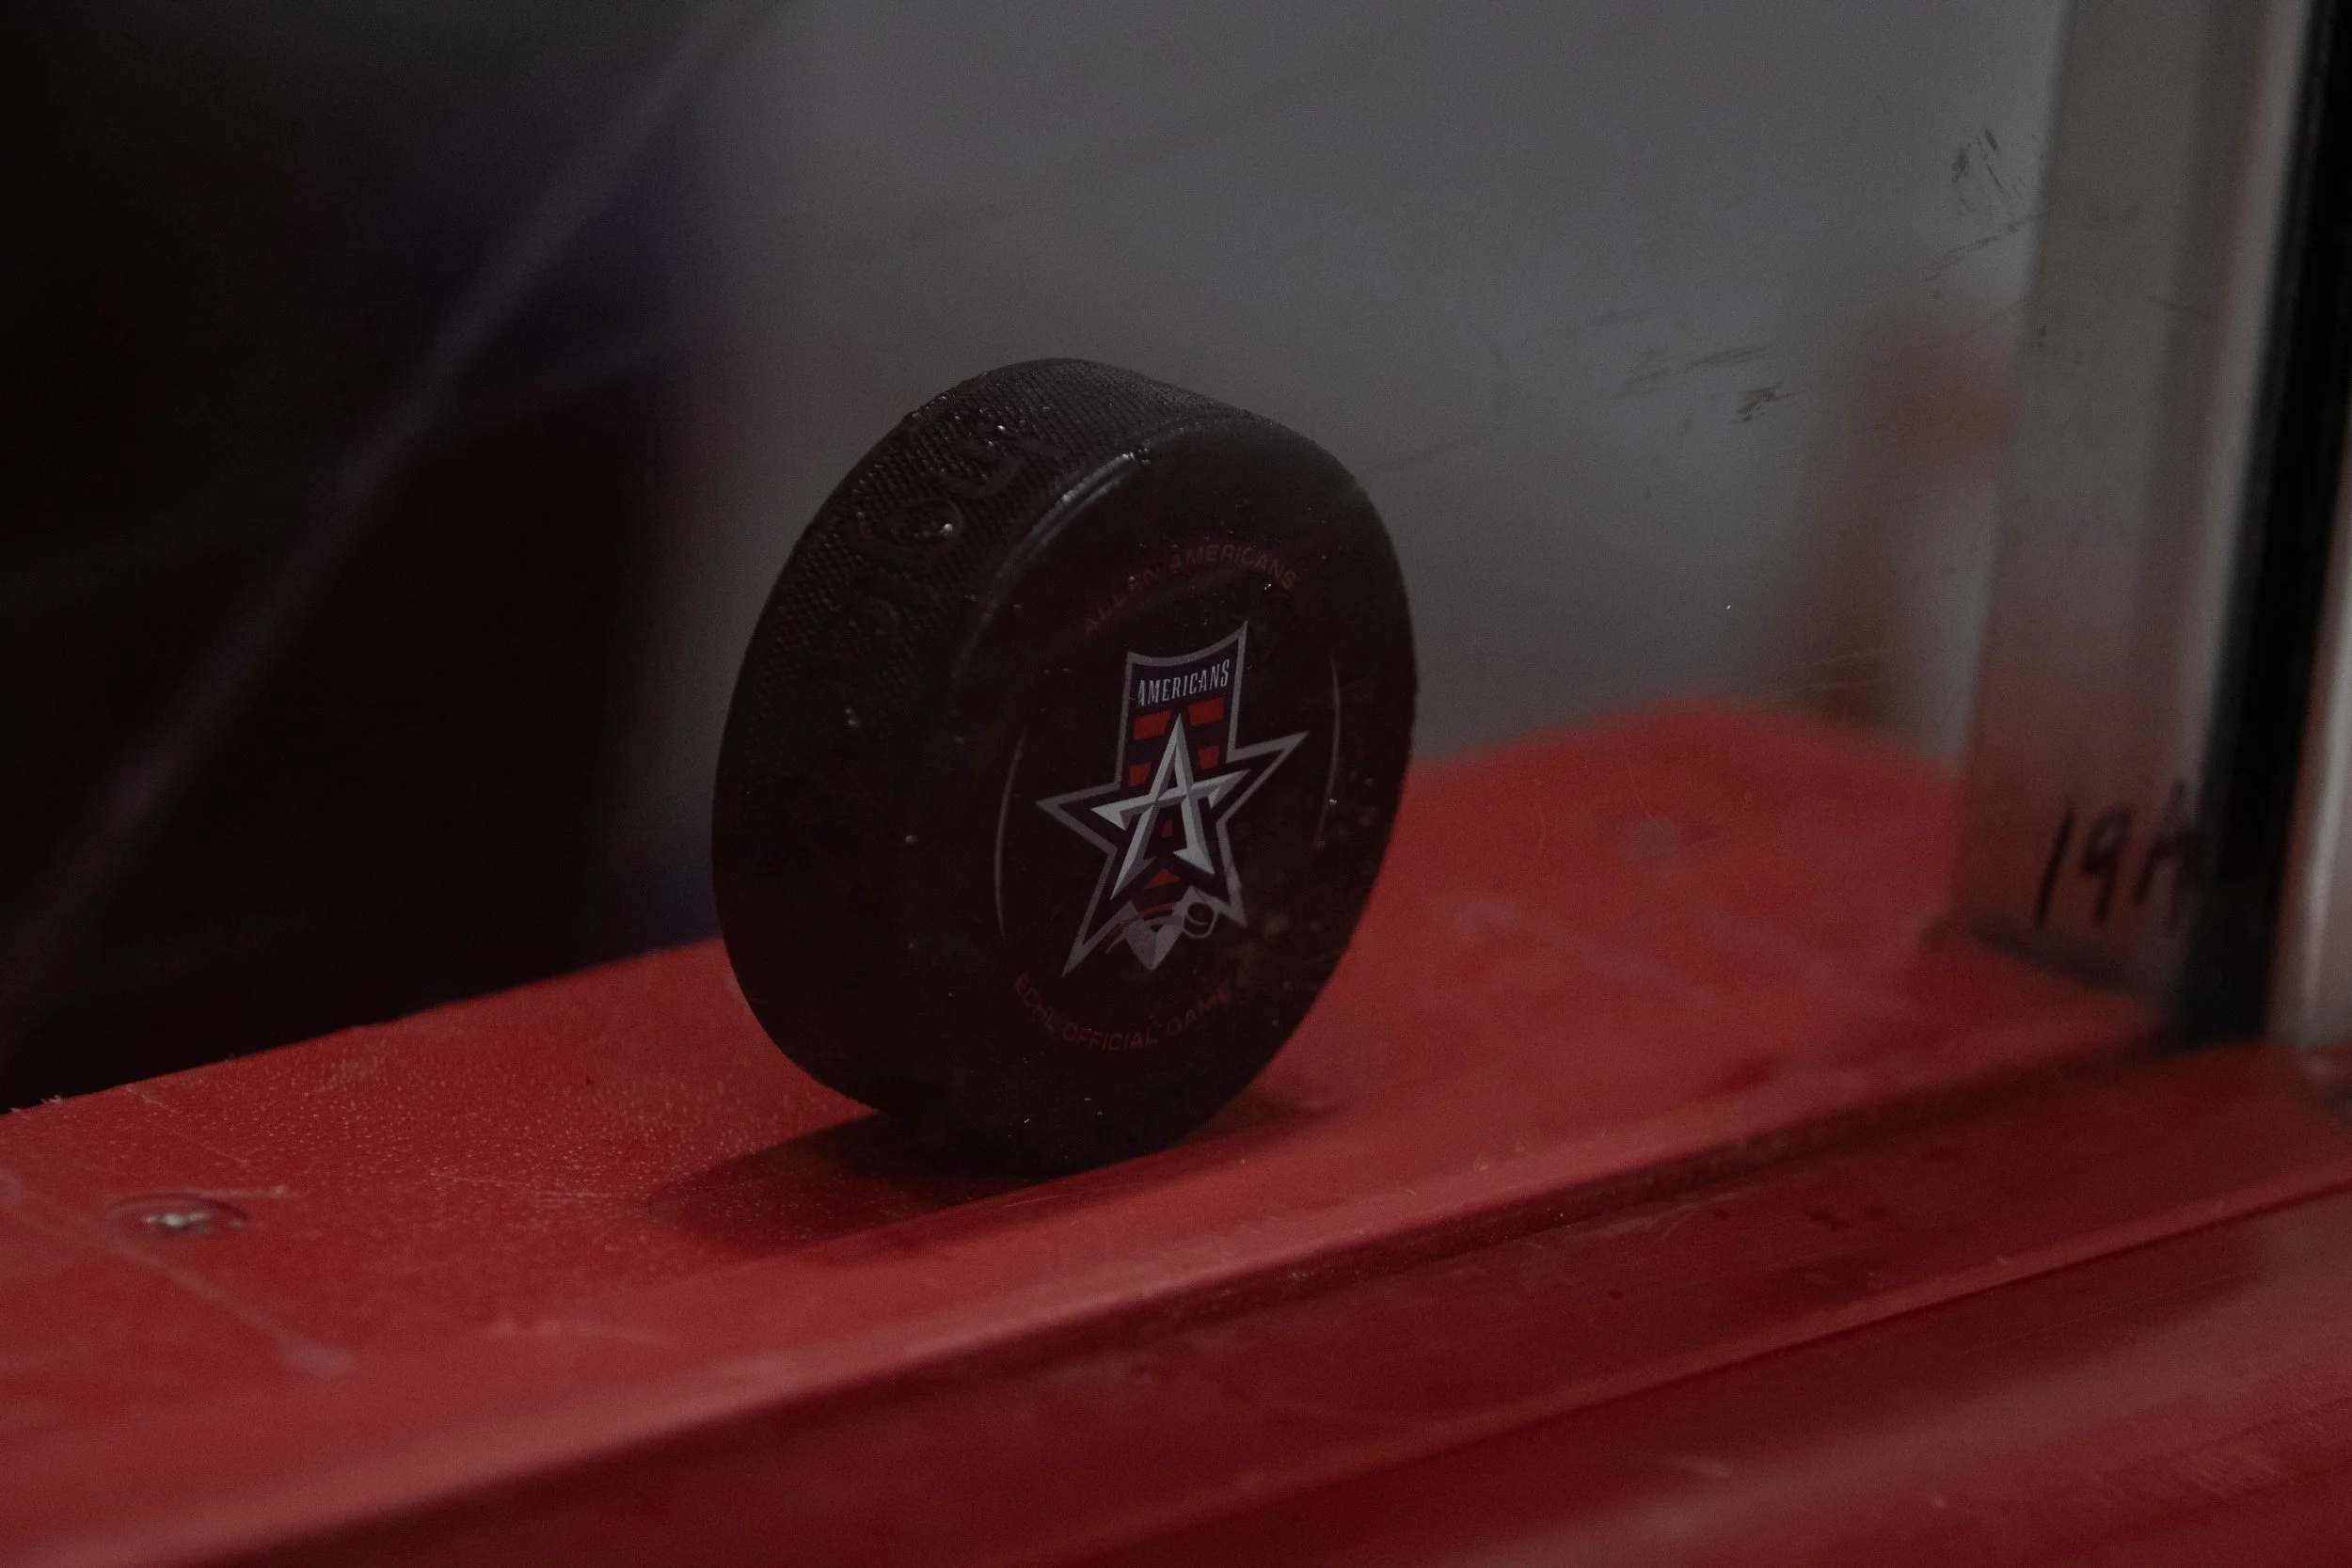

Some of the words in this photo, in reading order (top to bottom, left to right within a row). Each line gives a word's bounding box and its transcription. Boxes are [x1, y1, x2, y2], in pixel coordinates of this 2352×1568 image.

[1169, 543, 1300, 591] AMERICANS
[1137, 658, 1230, 706] AMERICANS
[1061, 1022, 1159, 1053] OFFICIAL
